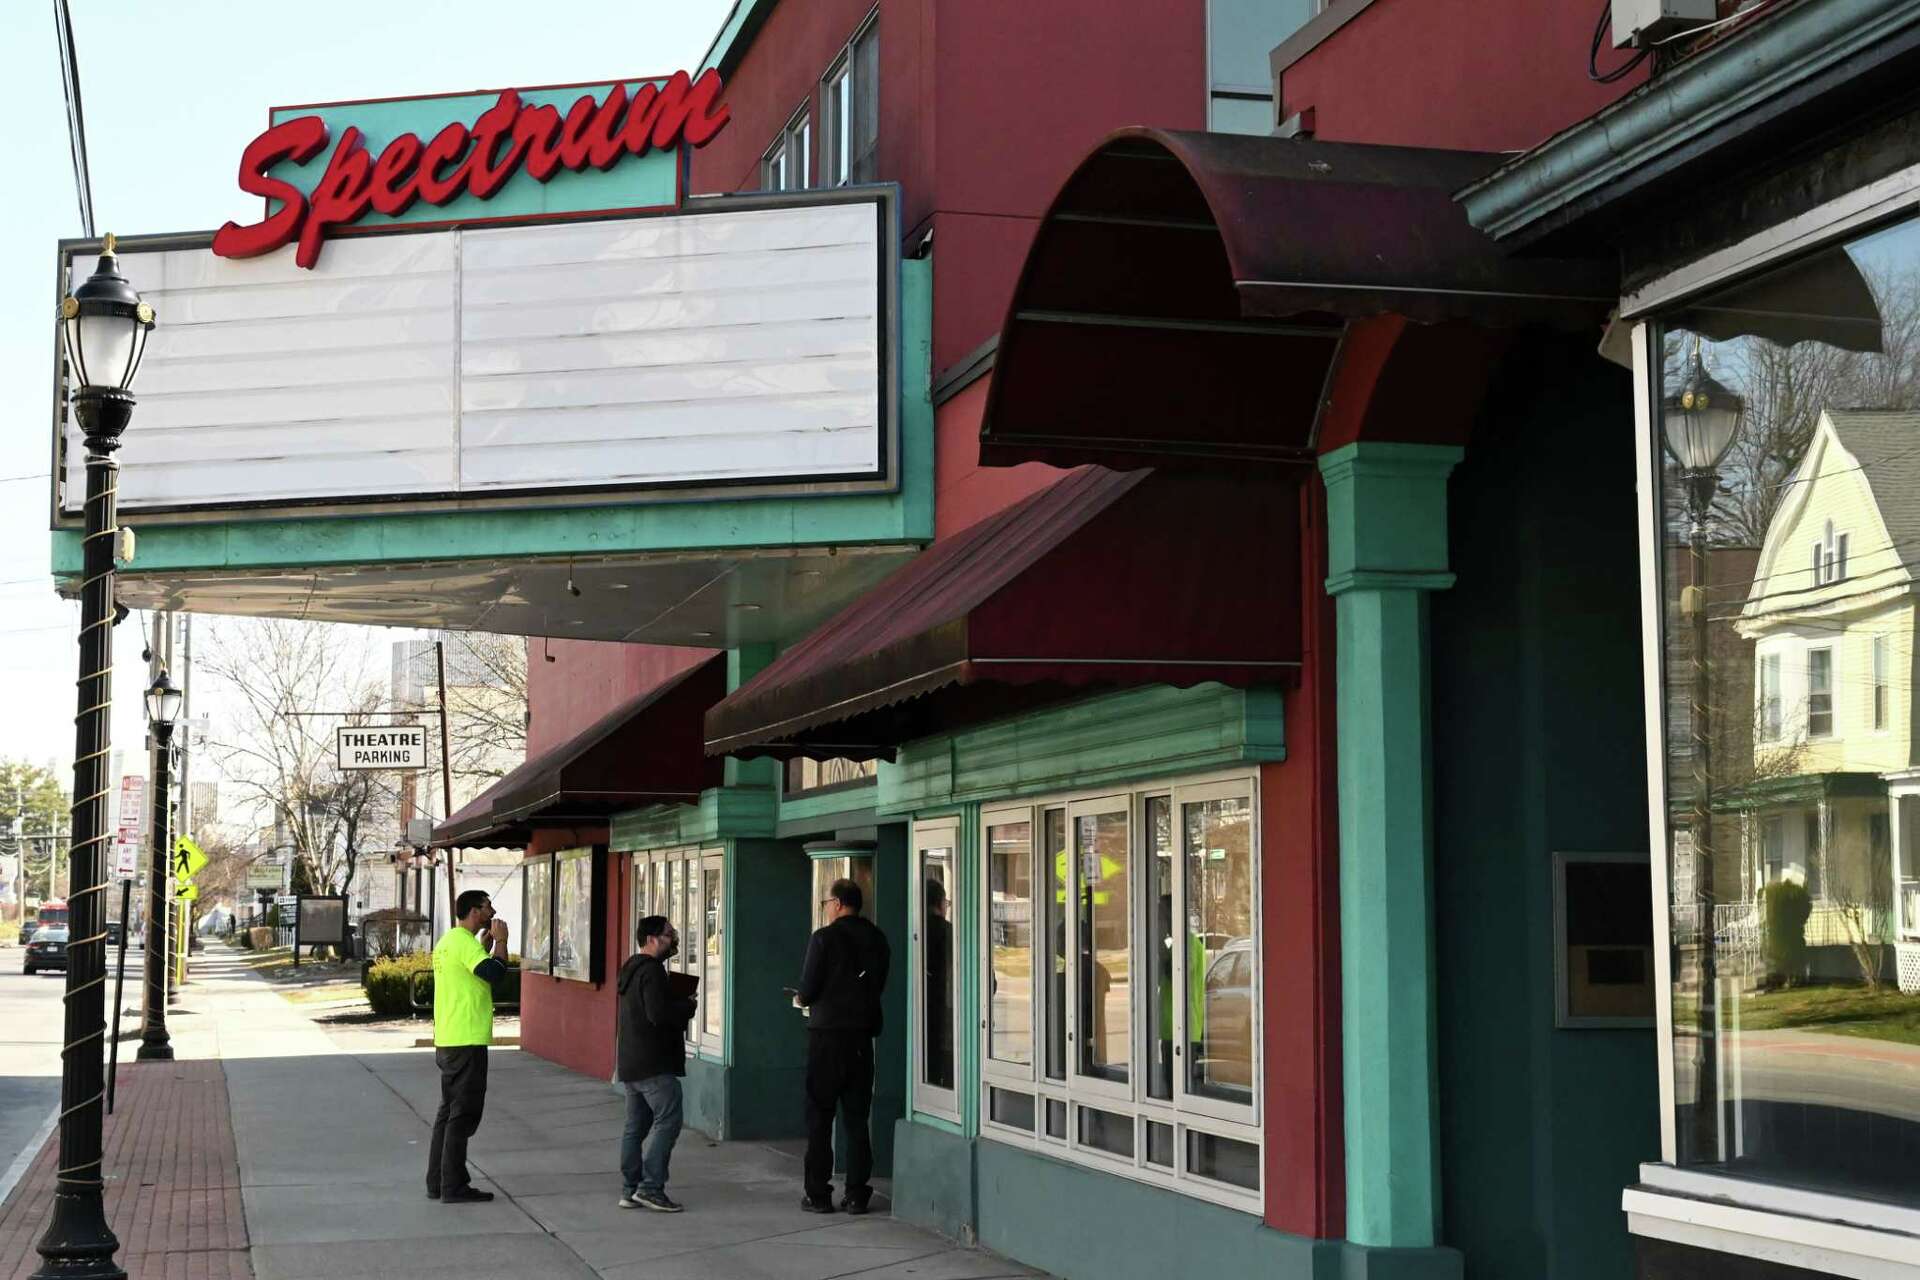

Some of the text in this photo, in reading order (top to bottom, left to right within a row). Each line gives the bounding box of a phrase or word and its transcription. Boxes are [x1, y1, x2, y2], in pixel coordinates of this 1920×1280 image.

[212, 68, 730, 270] Spectrum
[342, 733, 421, 747] THEATRE
[354, 750, 410, 763] PARKING
